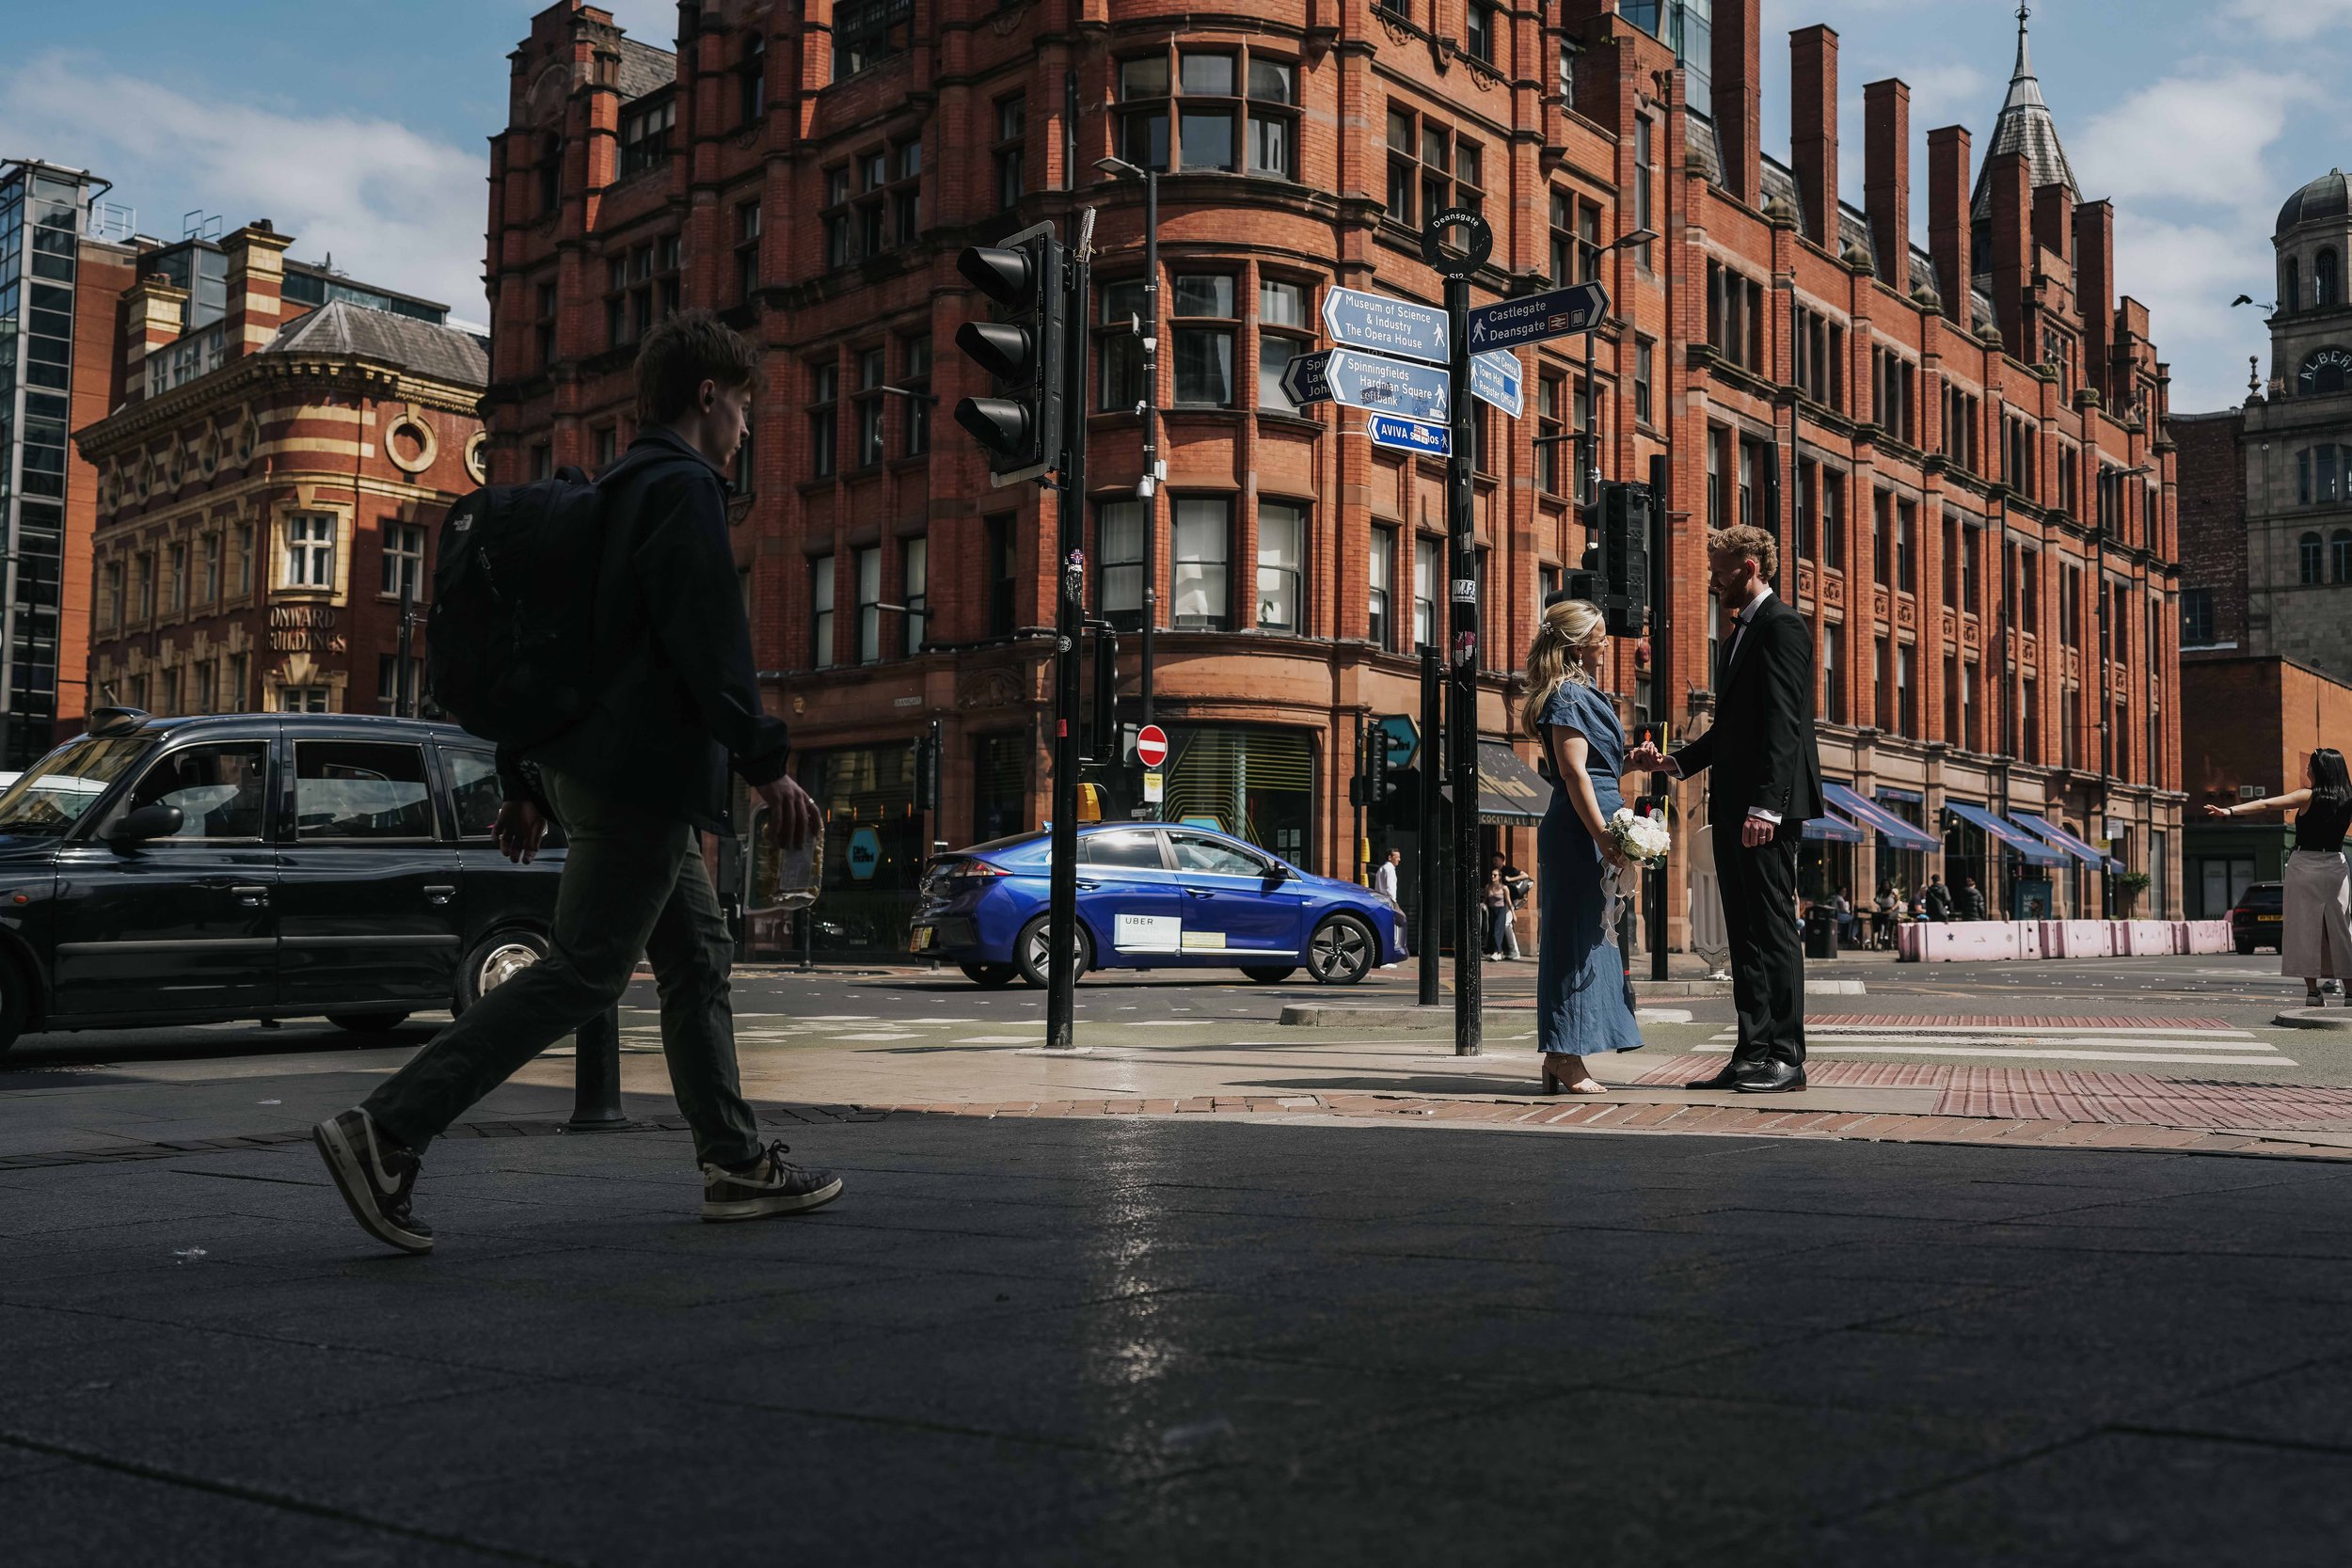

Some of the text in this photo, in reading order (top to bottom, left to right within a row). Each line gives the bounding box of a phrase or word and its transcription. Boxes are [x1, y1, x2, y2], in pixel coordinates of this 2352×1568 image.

[1432, 213, 1480, 229] Deansgate
[1345, 294, 1431, 324] Museum of Science
[1488, 301, 1547, 322] Castlegate
[1366, 313, 1412, 335] & Industry
[1489, 321, 1546, 341] Deansgate
[1345, 323, 1422, 349] The Opera House
[1347, 358, 1409, 381] Spinningfields
[1479, 365, 1503, 388] Town Hall
[1502, 357, 1518, 376] Central
[1359, 375, 1433, 401] Hardman Square
[1479, 380, 1516, 408] Register Office
[1381, 423, 1439, 446] AVIVA sios
[270, 607, 336, 628] ONWARD
[266, 631, 346, 653] BUILDINGS
[1481, 815, 1514, 826] COCKTAIL
[1516, 817, 1520, 826] &
[1522, 817, 1536, 827] LTE
[1125, 917, 1153, 926] UBER
